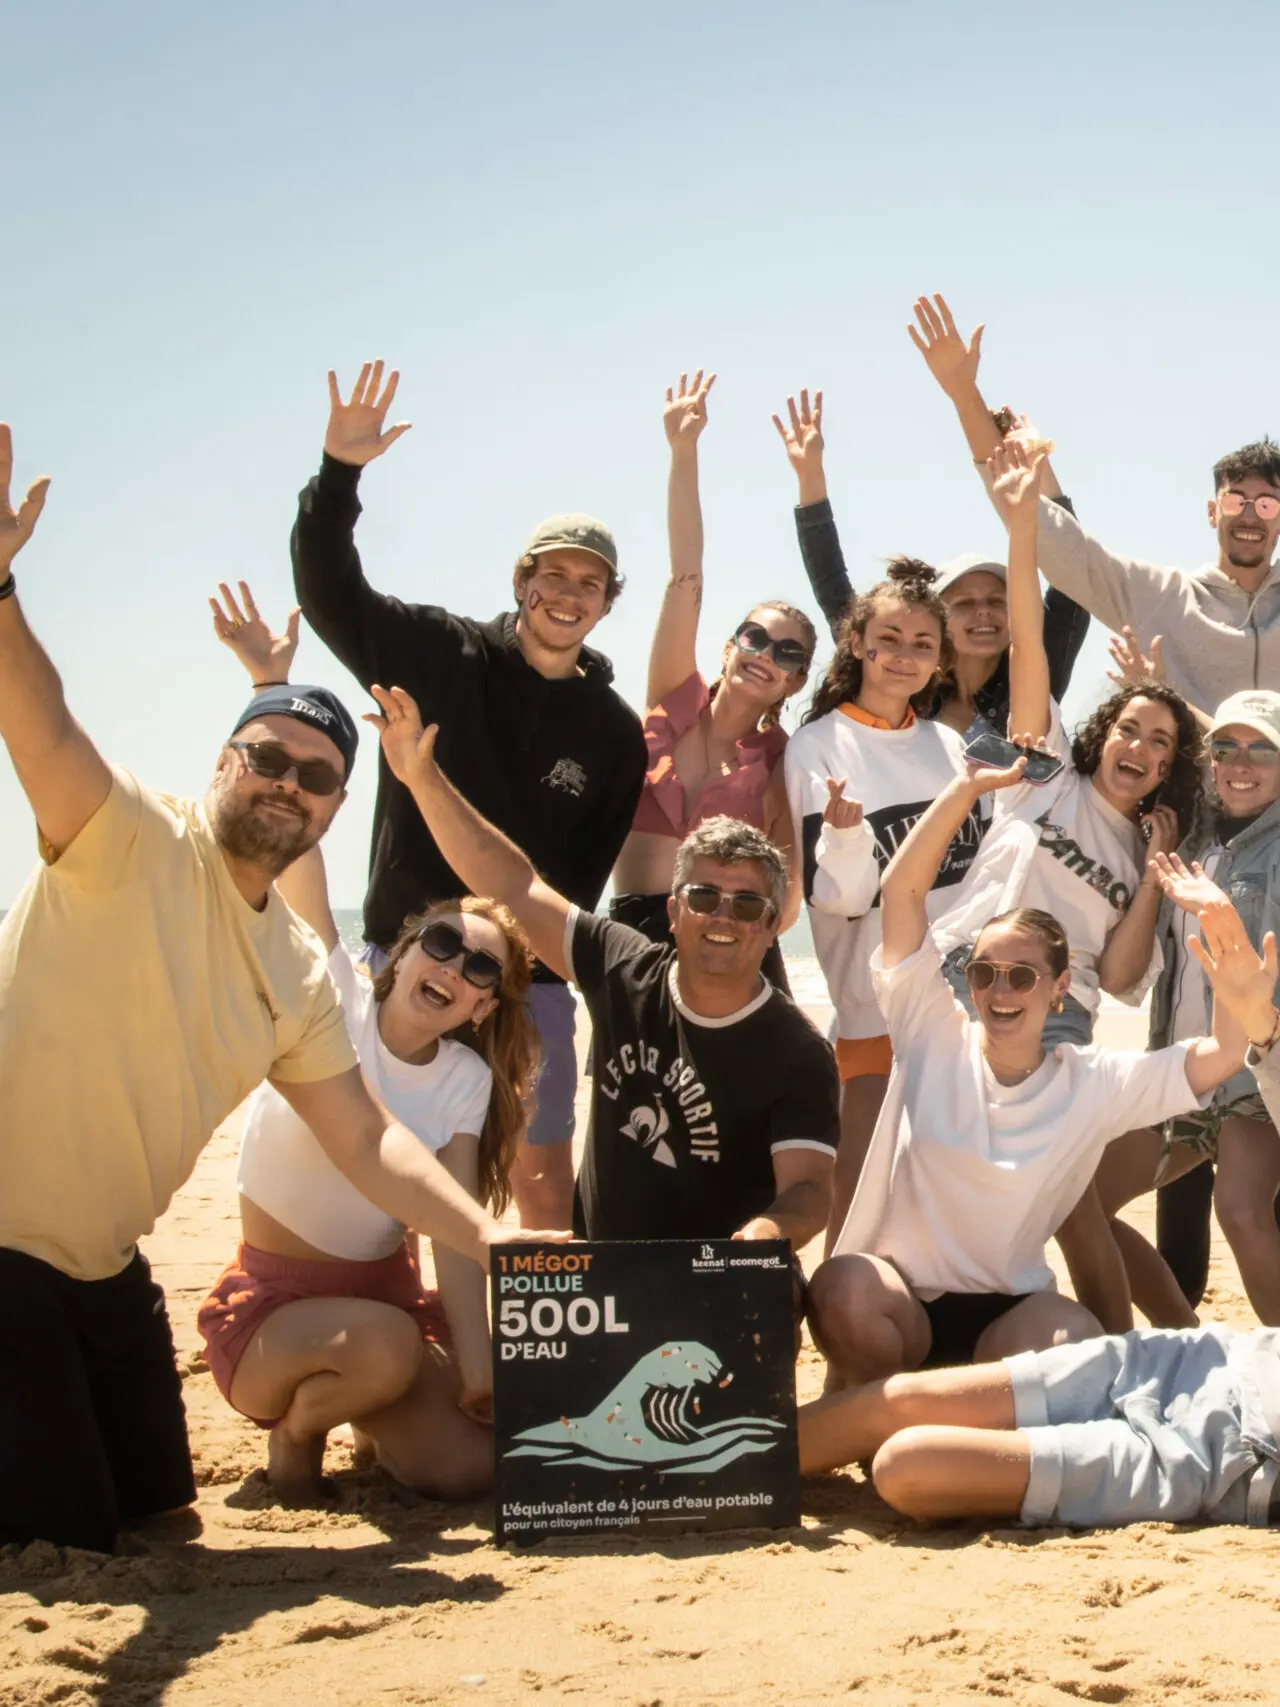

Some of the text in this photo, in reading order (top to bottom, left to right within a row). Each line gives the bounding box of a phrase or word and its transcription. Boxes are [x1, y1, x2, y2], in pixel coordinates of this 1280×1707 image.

[663, 1057, 720, 1163] SPORTIF
[498, 1249, 593, 1273] 1 MÉGOT
[692, 1258, 725, 1268] keenat
[729, 1256, 780, 1269] ecomegot
[500, 1275, 583, 1294] POLLUE
[499, 1296, 629, 1338] 500L
[501, 1341, 567, 1360] D'EAU
[502, 1493, 773, 1518] L'équivalent de 4 jours d'eau potable
[503, 1515, 641, 1532] pour un citoyen français
